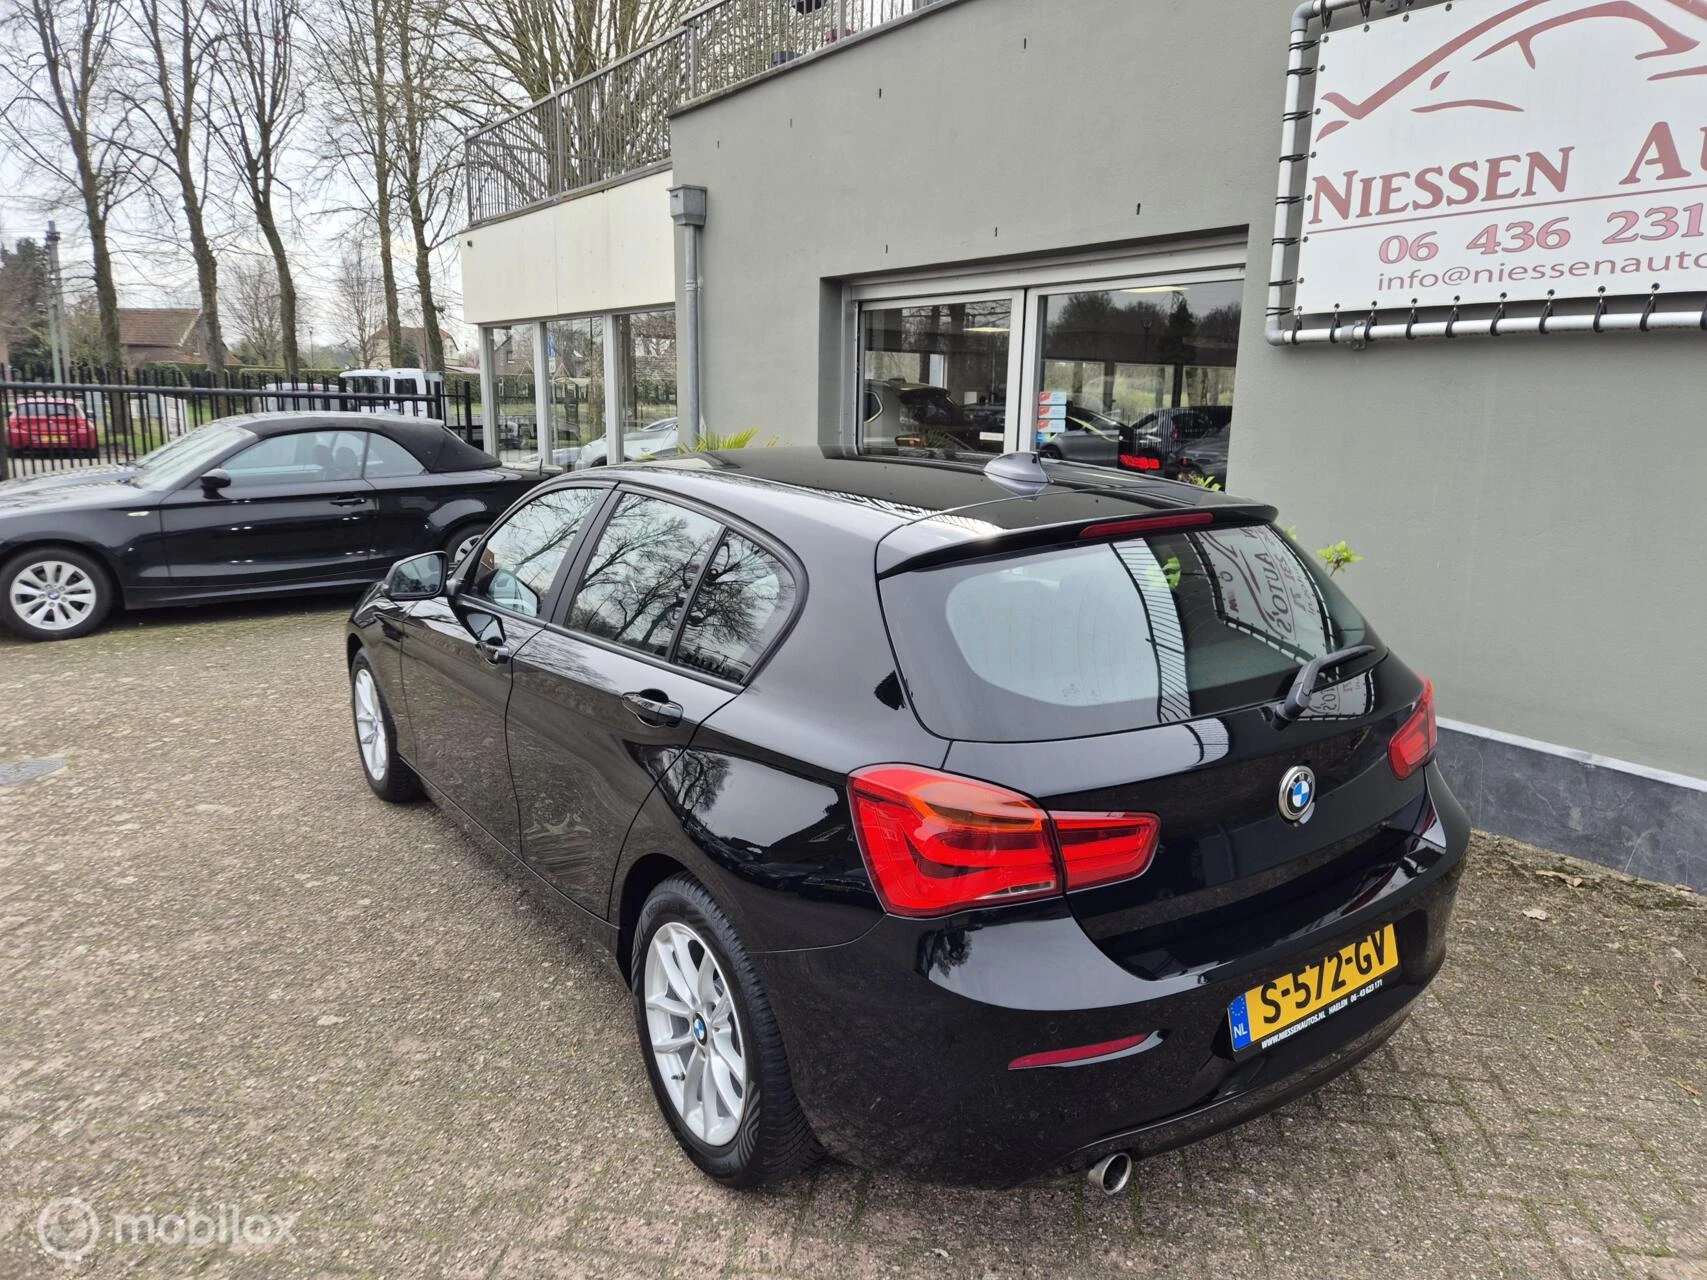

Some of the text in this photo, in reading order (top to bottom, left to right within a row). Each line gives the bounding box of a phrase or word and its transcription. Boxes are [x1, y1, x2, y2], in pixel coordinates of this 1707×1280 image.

[1308, 121, 1707, 225] NIESSEN A
[1378, 203, 1704, 265] 06 436 231
[1260, 928, 1385, 1024] S-572-GV
[1233, 1022, 1248, 1038] NL
